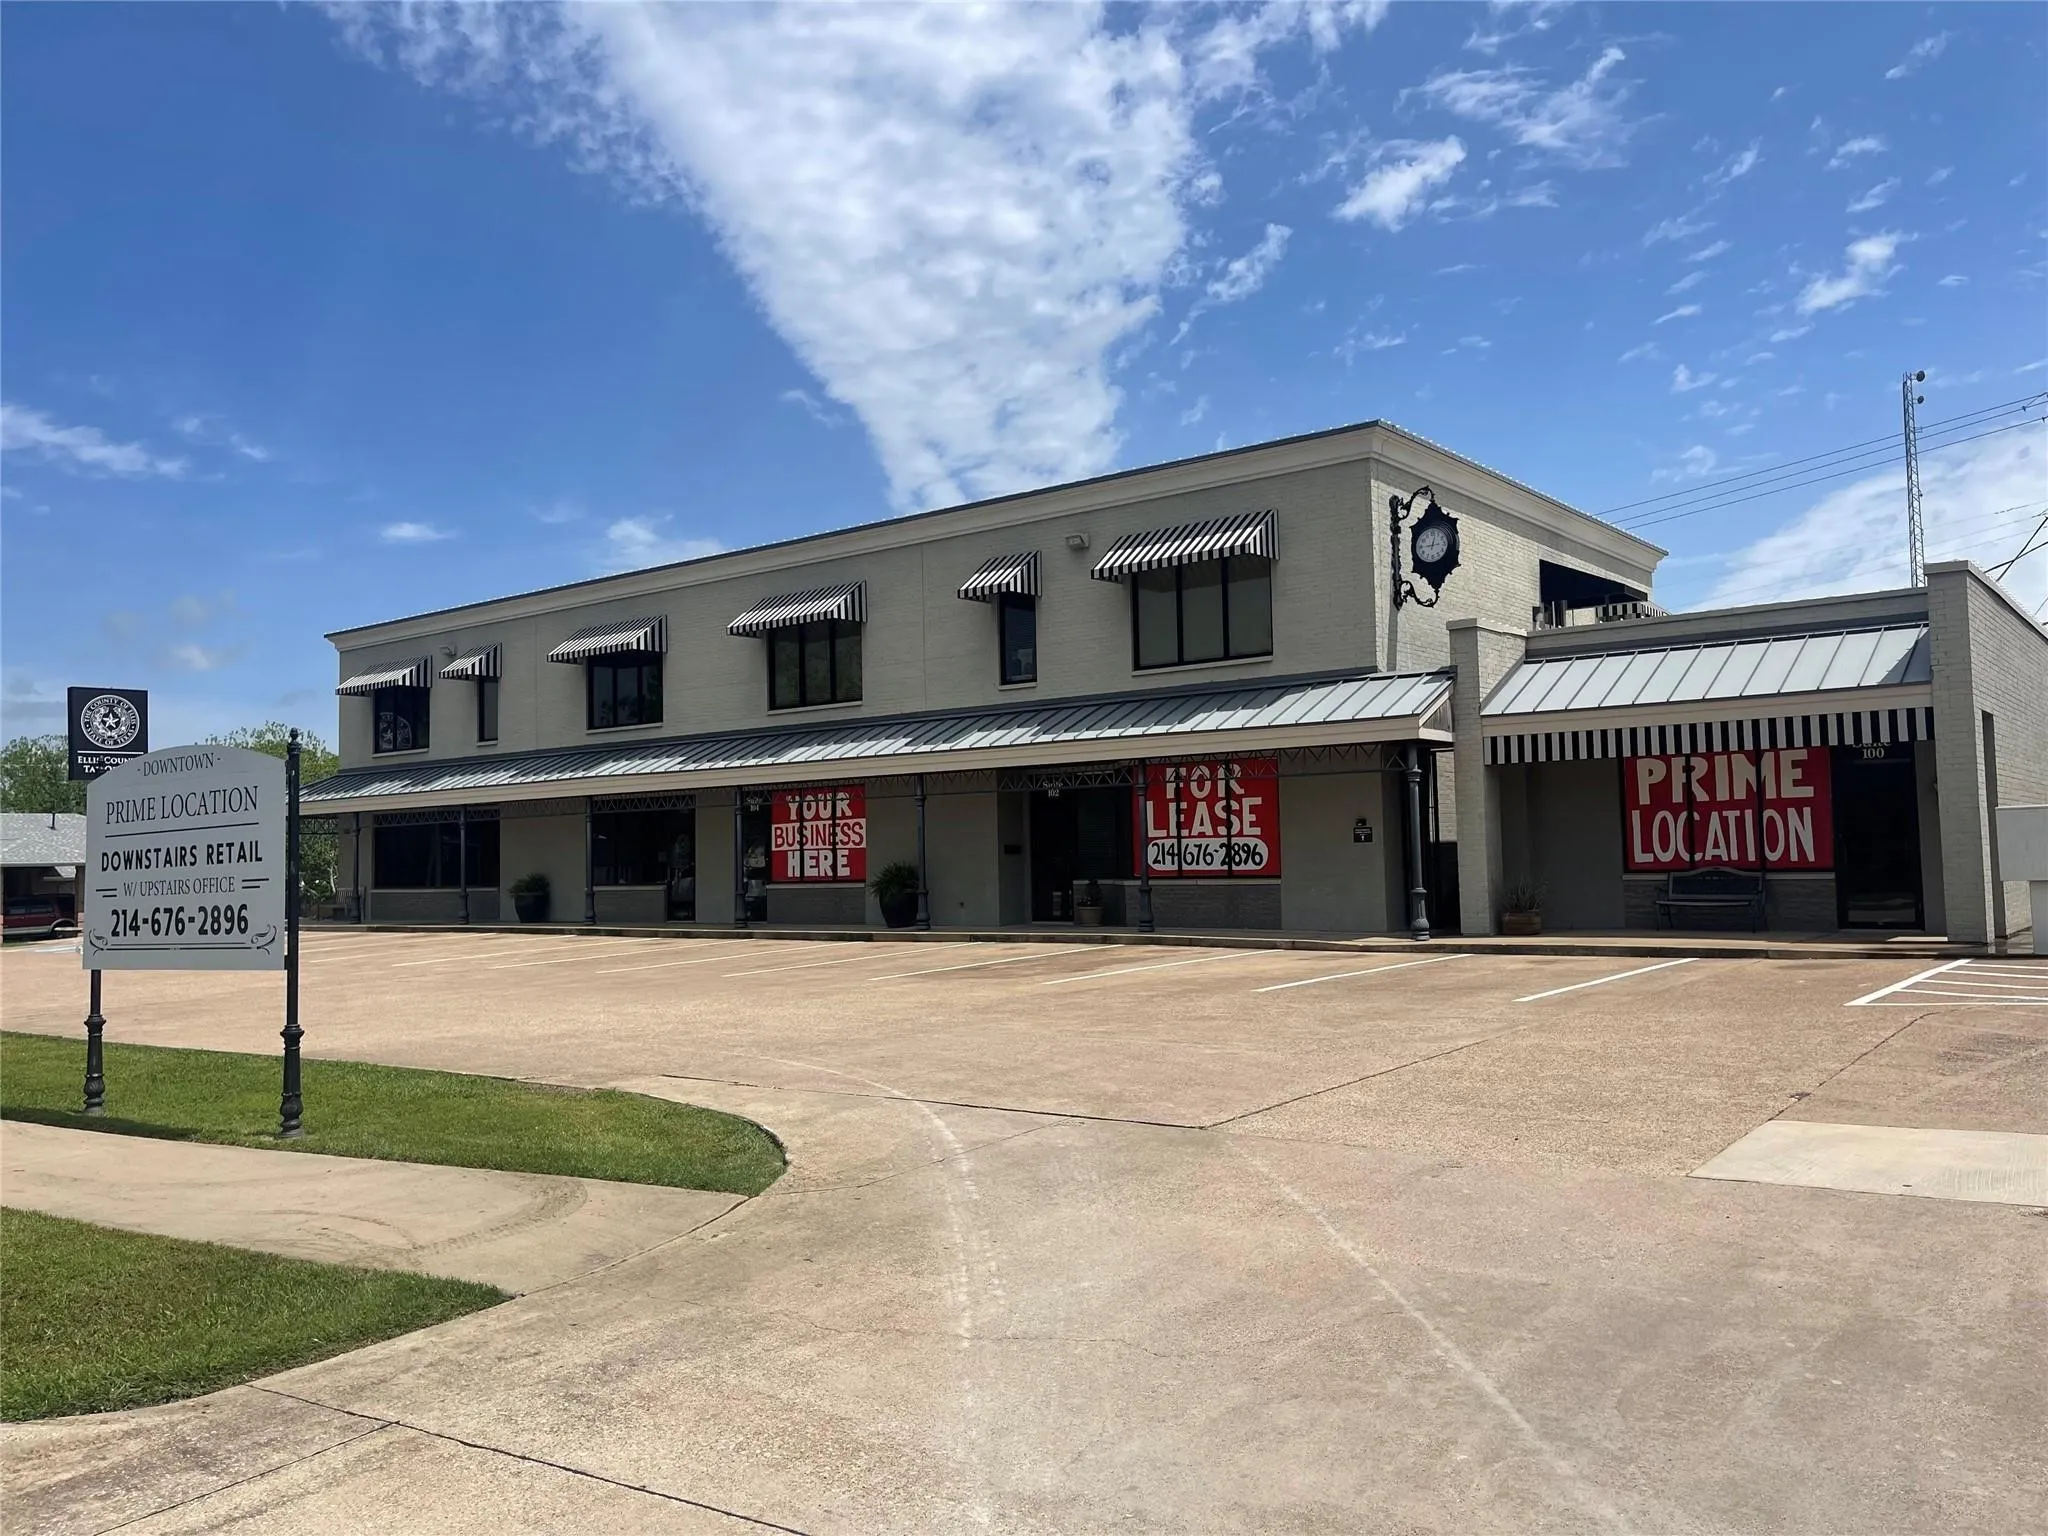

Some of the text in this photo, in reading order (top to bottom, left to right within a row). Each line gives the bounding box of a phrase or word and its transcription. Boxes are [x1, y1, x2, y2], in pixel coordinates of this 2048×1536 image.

[143, 752, 215, 777] DOWNTOWN
[1862, 747, 1885, 759] 100
[1165, 763, 1245, 799] FOR
[1636, 749, 1815, 805] PRIME
[106, 785, 259, 825] PRIME LOCATION
[786, 791, 853, 821] YOUR
[1146, 797, 1263, 838] LEASE
[774, 821, 864, 849] BUSINESS
[1631, 806, 1816, 864] LOCATION
[101, 840, 263, 872] DOWNSTAIRS RETAIL
[787, 849, 851, 878] HERE
[123, 876, 236, 897] W/ UPSTAIRS OFFICE
[110, 903, 249, 938] 214-676-2896
